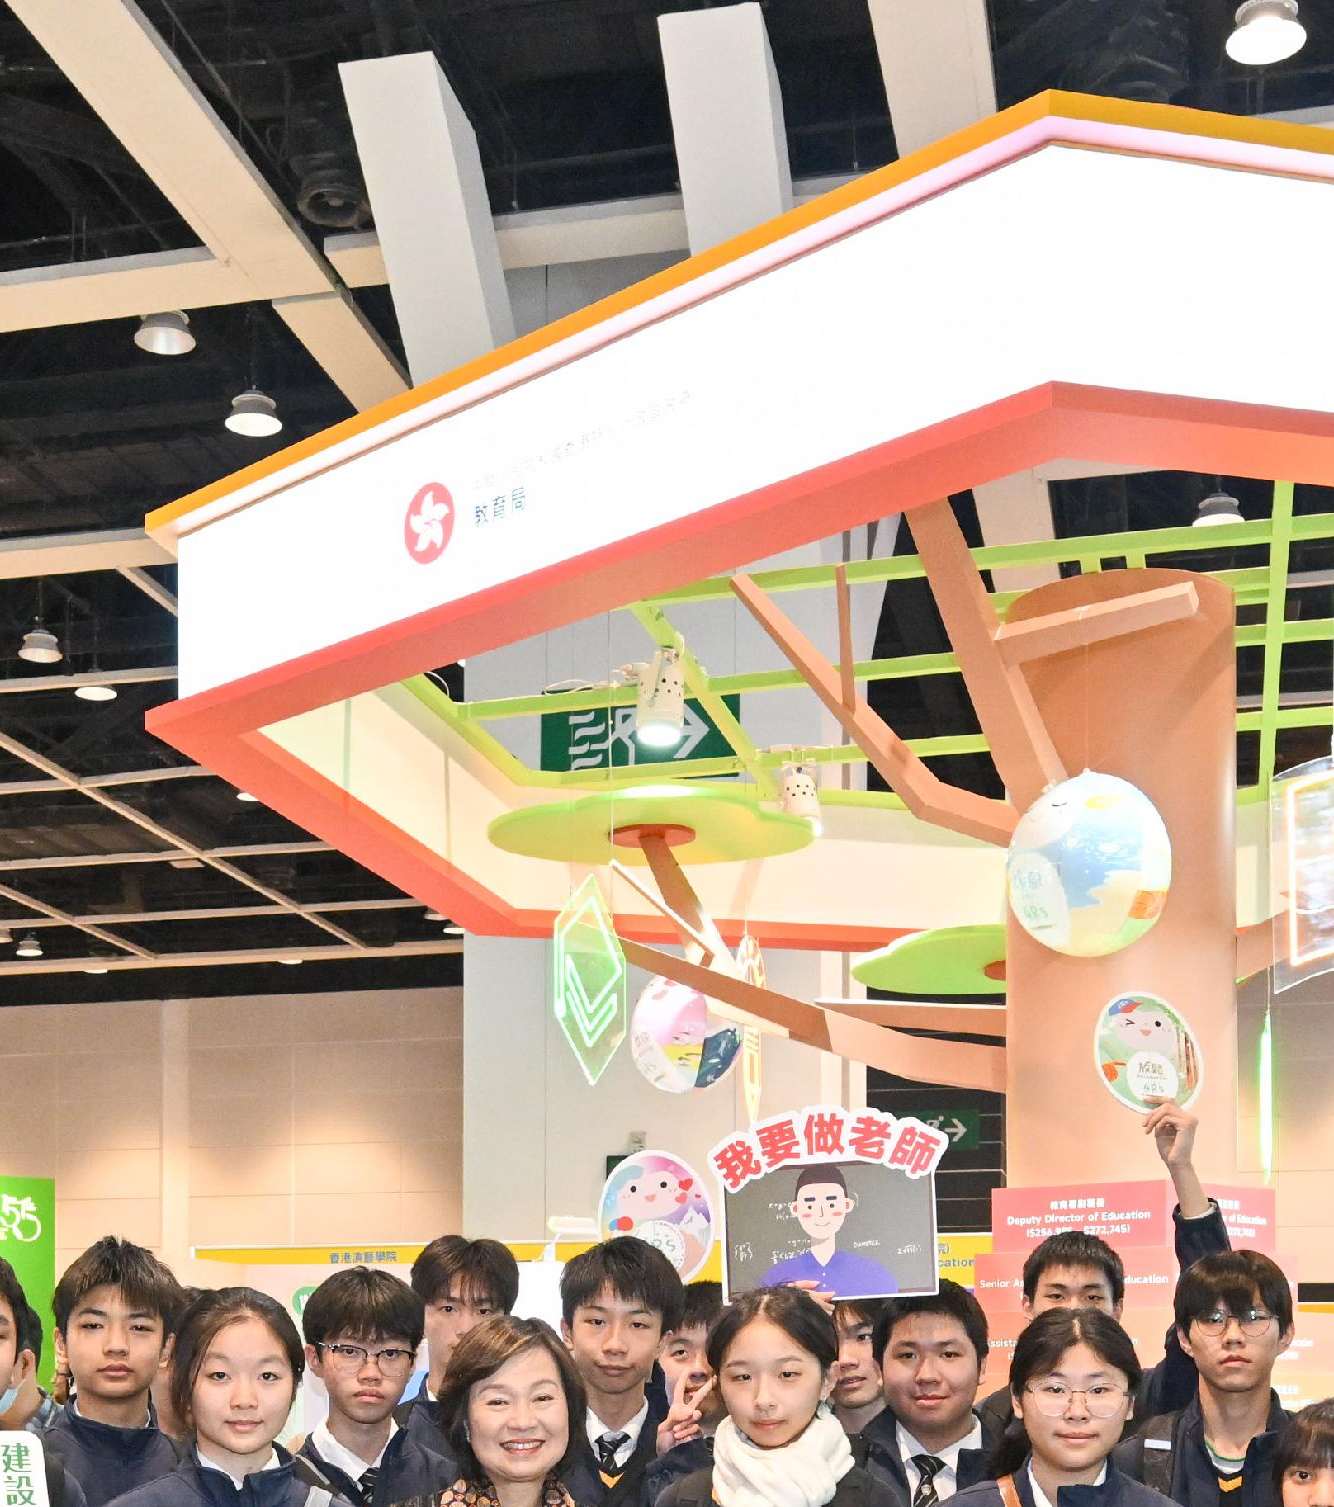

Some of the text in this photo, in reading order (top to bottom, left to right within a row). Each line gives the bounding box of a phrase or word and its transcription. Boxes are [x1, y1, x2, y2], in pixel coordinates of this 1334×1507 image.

[475, 486, 525, 528] 教育局
[714, 1113, 941, 1188] 我要做老師
[1007, 1210, 1151, 1226] Deputy Director of Education
[979, 1279, 1010, 1289] Senior
[1124, 1275, 1169, 1285] ducation
